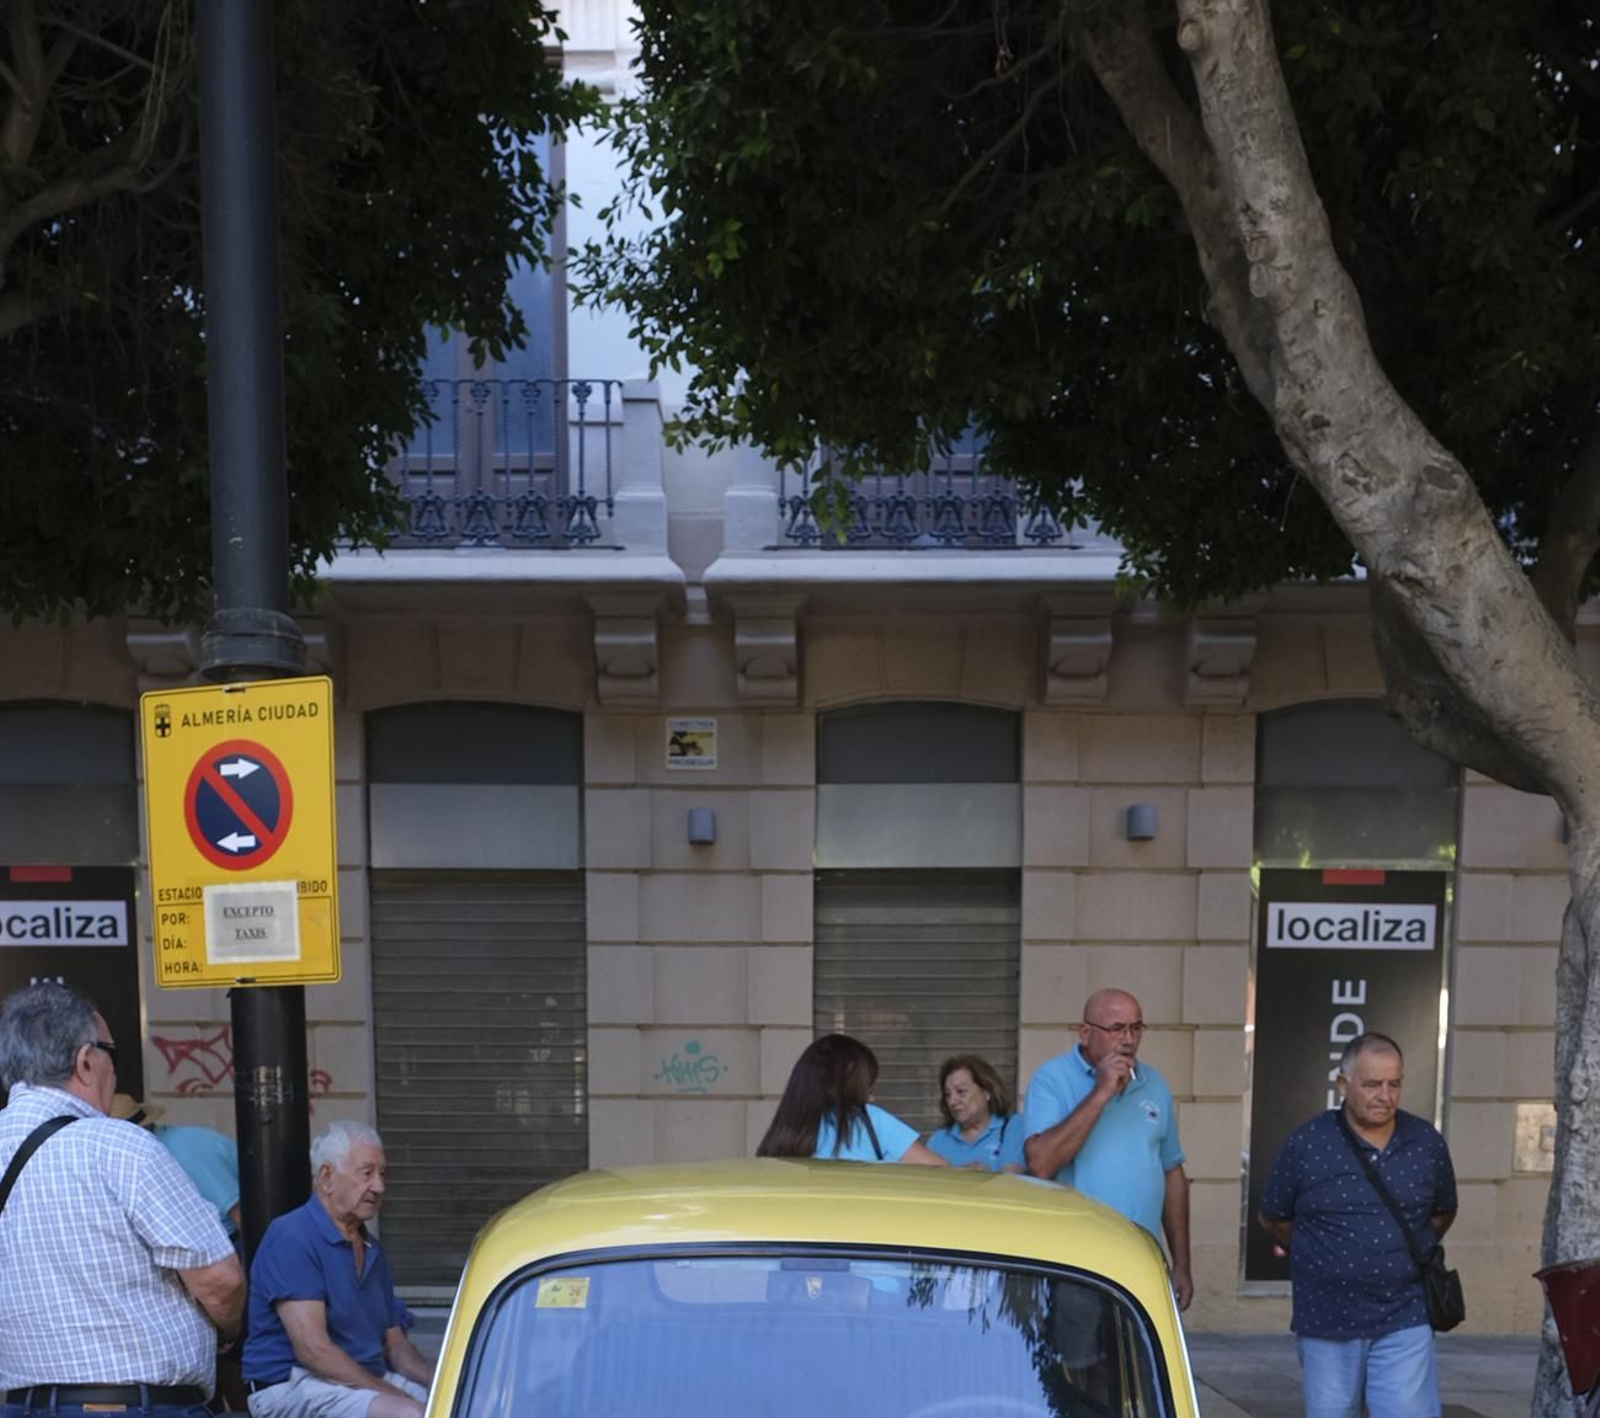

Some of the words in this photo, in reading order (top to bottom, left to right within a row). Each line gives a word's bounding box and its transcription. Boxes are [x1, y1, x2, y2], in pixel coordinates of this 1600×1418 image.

[181, 705, 253, 728] ALMERÍA
[257, 702, 319, 722] CIUDAD
[158, 886, 202, 902] ESTACIO
[296, 880, 328, 893] IBIDO
[161, 913, 190, 925] POR:
[223, 905, 275, 918] EXCEPTO
[0, 906, 119, 939] caliza
[1276, 908, 1427, 943] localiza
[235, 928, 267, 940] TAXIS
[163, 935, 187, 950] DÍA:
[165, 962, 203, 974] HORA:
